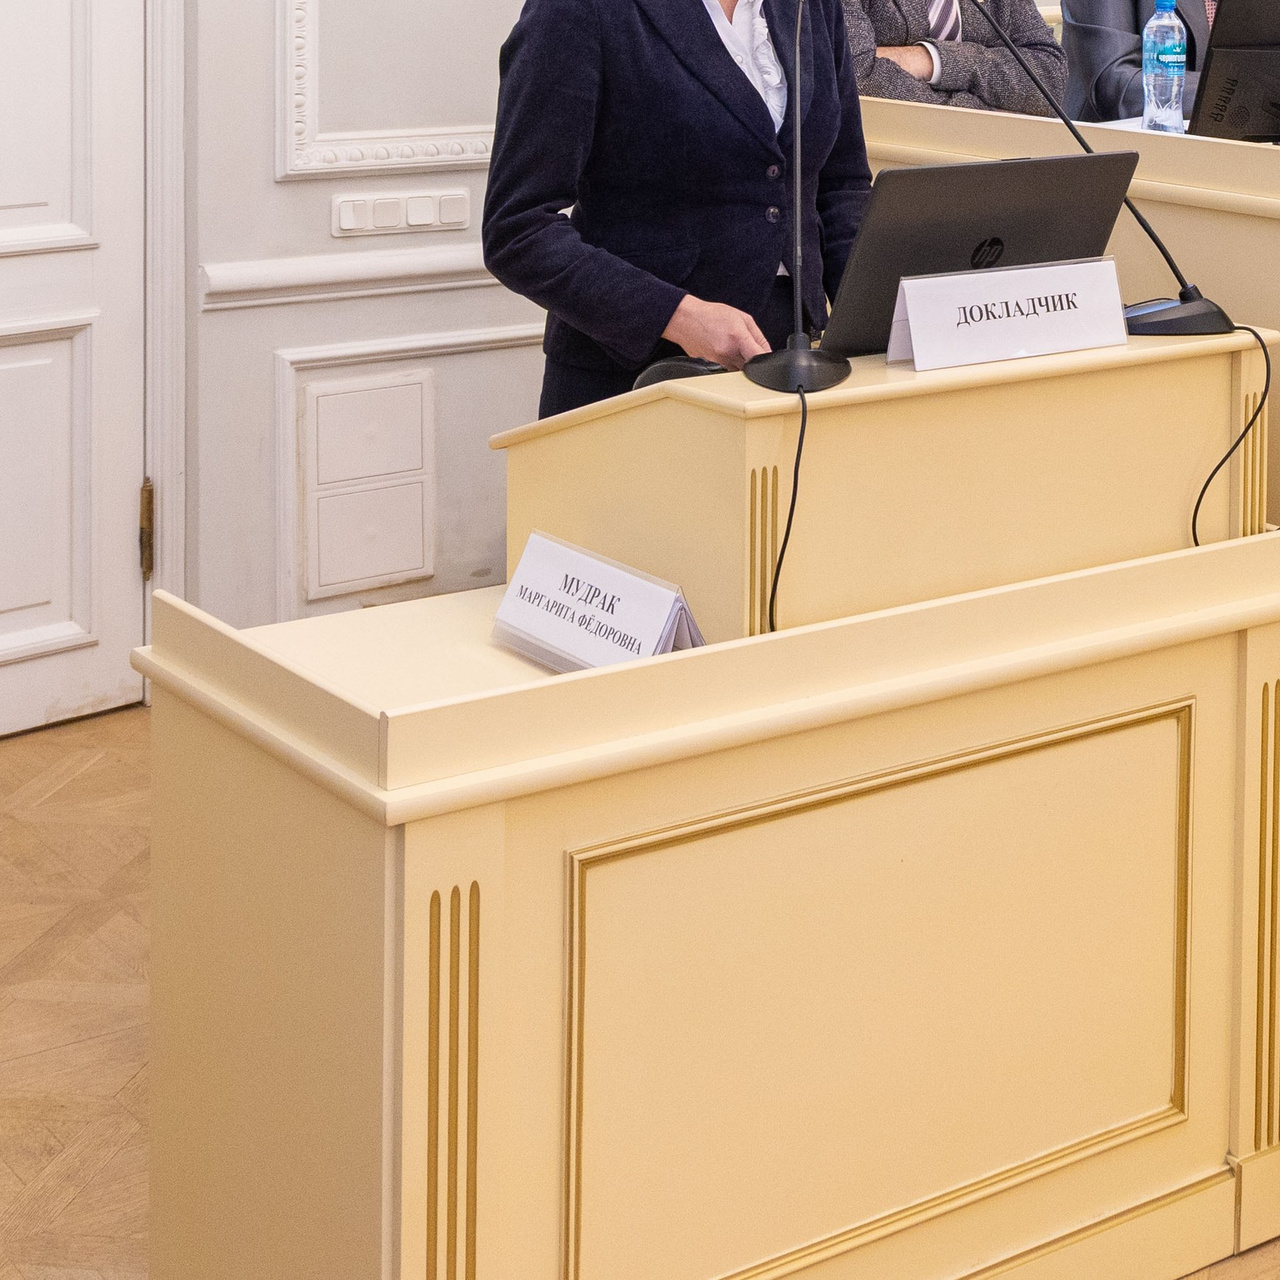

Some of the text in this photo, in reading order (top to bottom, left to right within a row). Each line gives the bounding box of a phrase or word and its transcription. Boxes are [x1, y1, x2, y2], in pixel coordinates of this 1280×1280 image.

[956, 292, 1078, 328] ДОКЛАДЧИК
[558, 573, 621, 615] МУДРАК
[515, 585, 642, 655] МАРГАРИТА ФЁДОРОВНА
